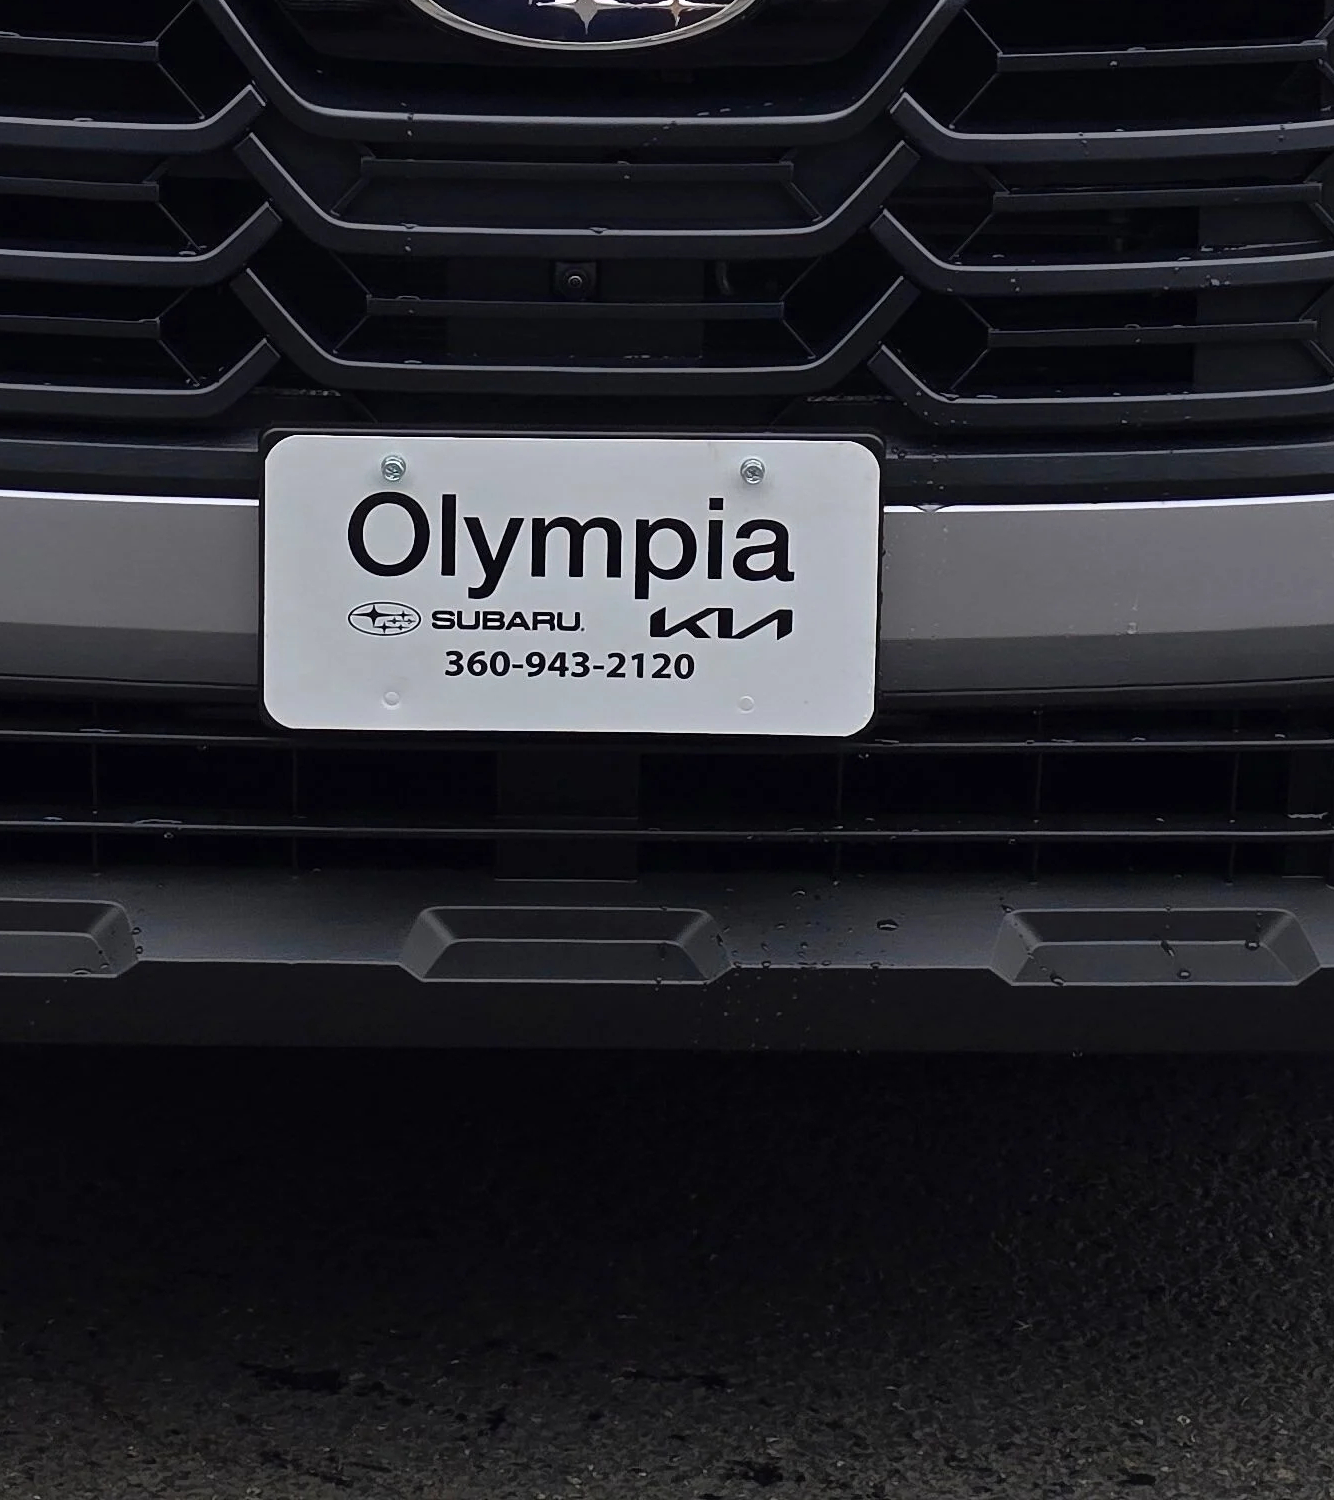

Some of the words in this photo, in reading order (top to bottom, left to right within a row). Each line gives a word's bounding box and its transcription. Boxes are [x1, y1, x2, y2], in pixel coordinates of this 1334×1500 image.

[347, 491, 795, 600] Olympia
[431, 609, 580, 633] SUBARU
[444, 650, 696, 680] 360-943-2120
